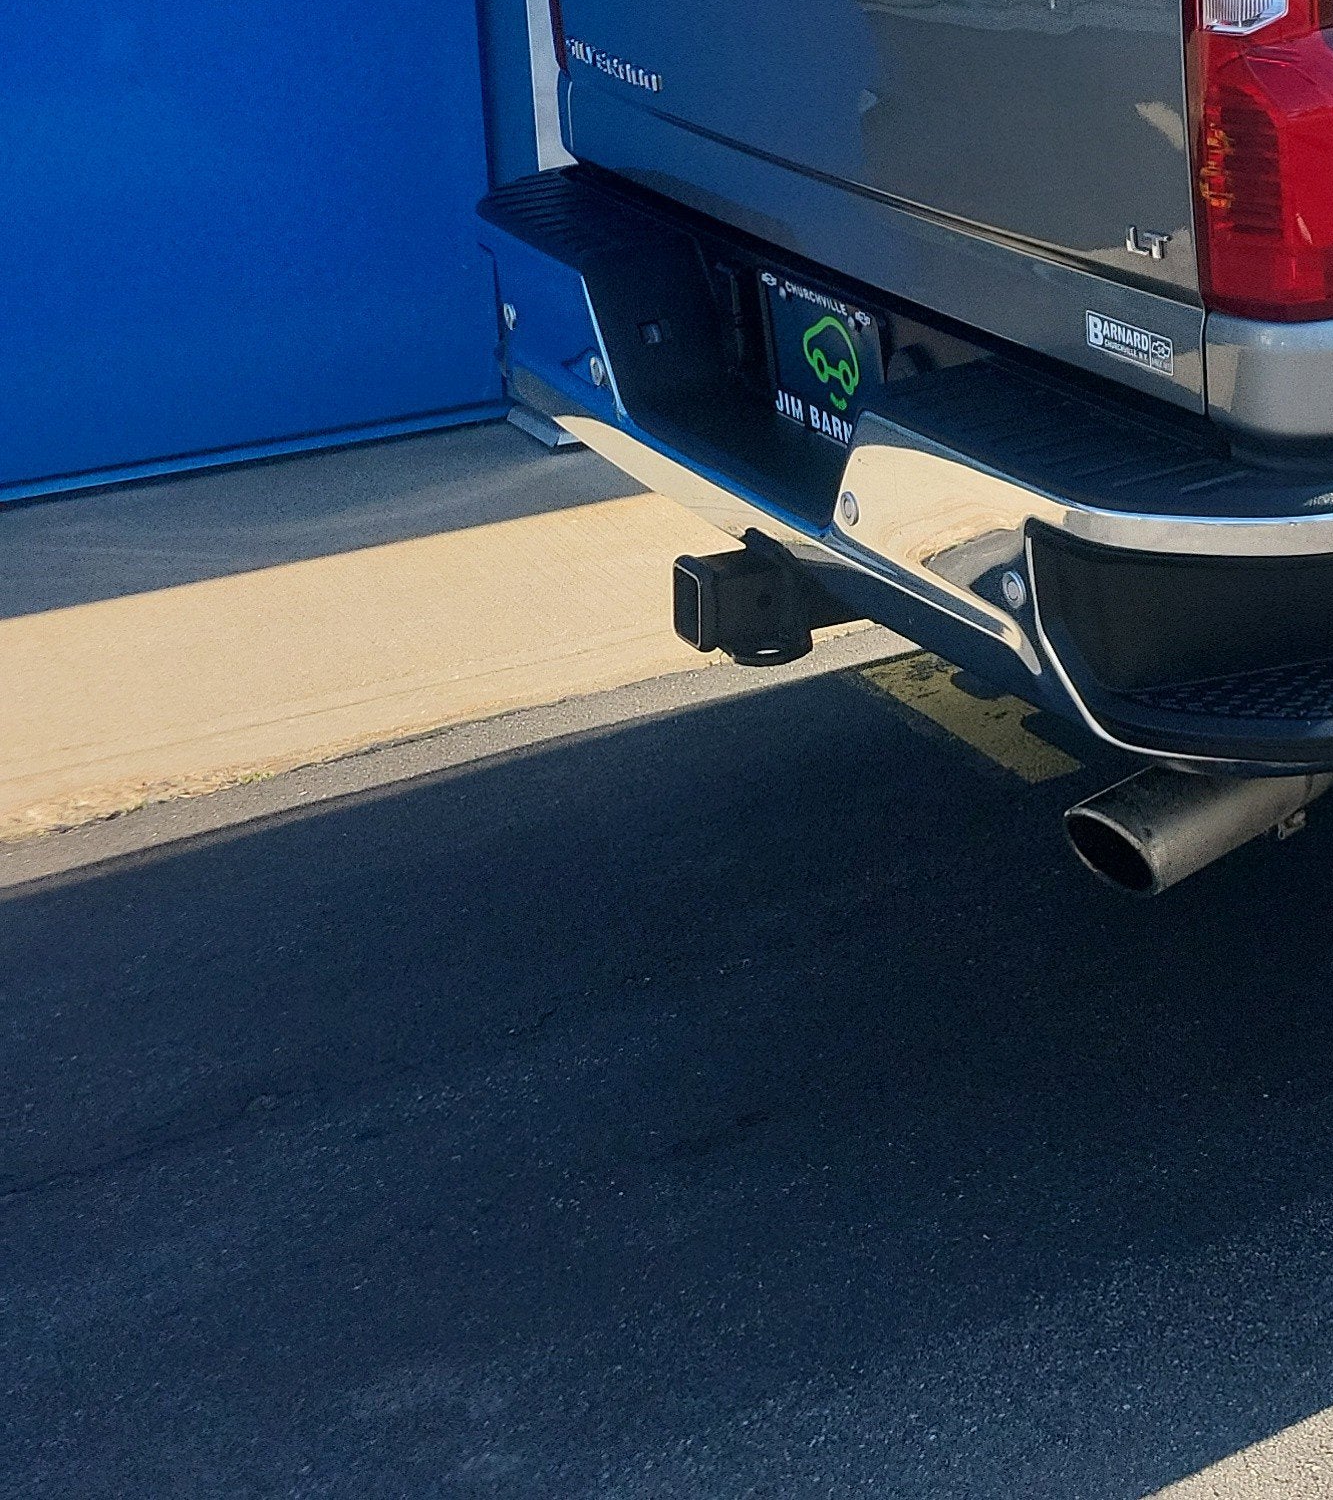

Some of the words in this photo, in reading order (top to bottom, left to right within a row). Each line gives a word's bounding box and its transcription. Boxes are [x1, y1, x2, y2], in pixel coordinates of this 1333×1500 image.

[1125, 225, 1170, 260] LT
[784, 281, 848, 317] CHURCHVILLE
[1088, 314, 1149, 352] BARNARD
[775, 389, 804, 422] JIM
